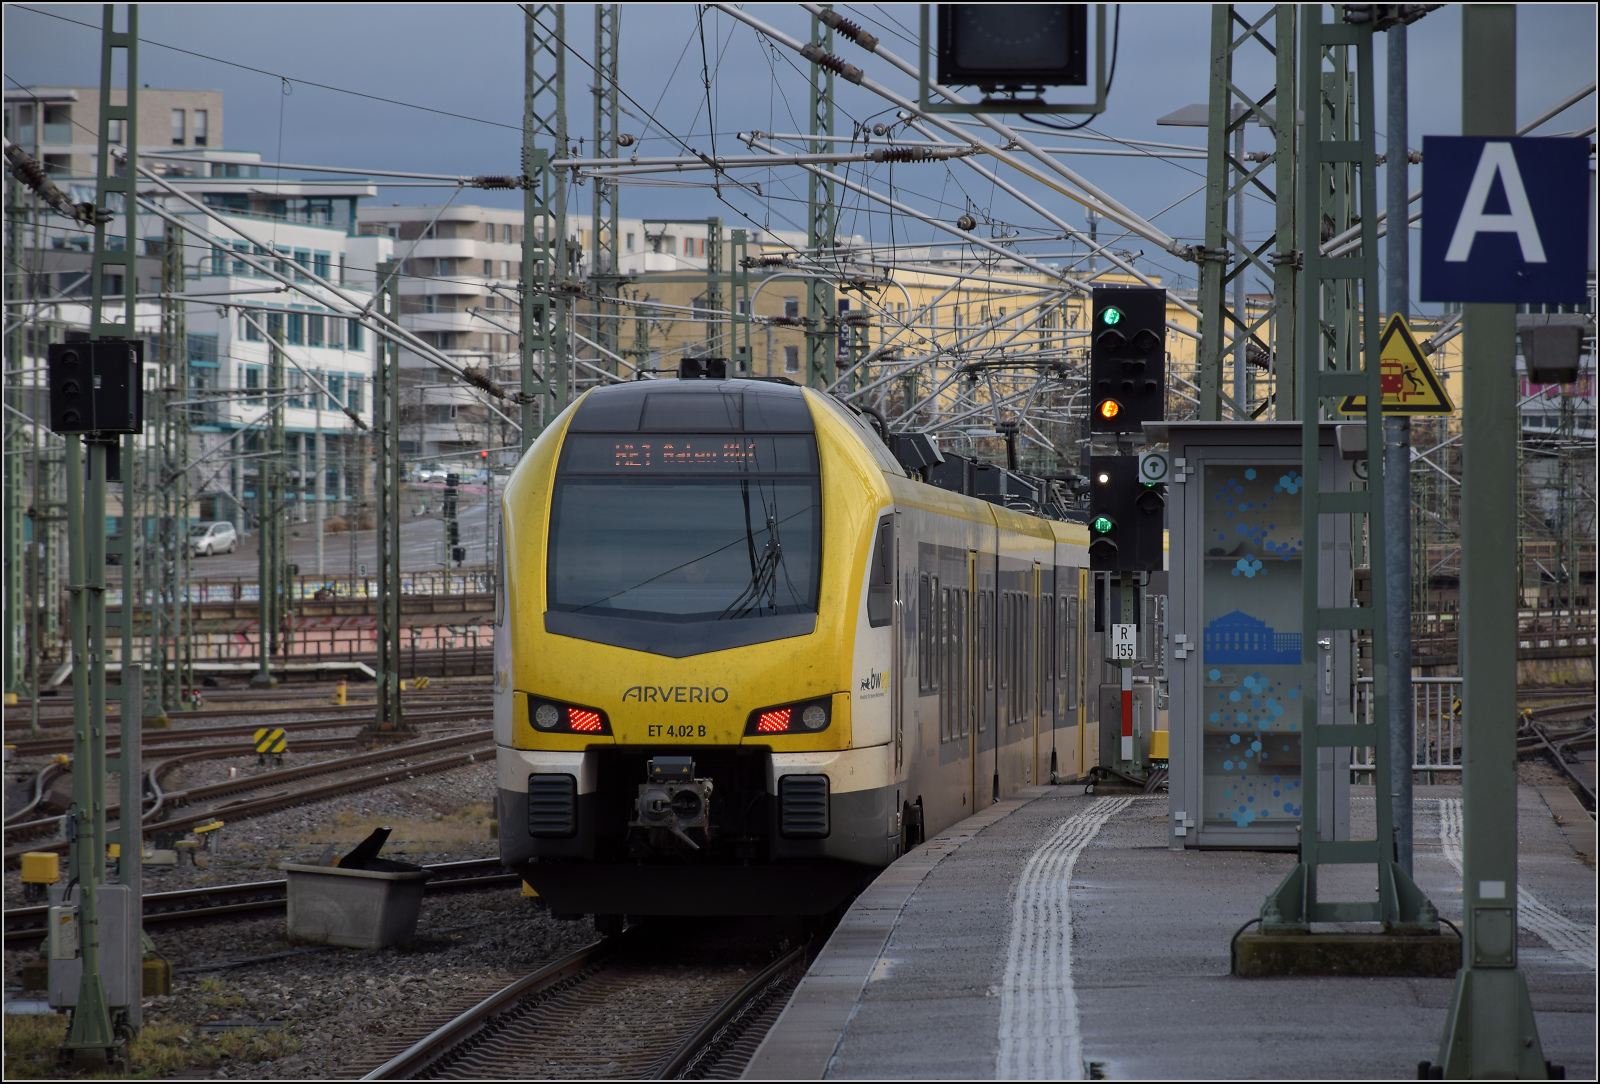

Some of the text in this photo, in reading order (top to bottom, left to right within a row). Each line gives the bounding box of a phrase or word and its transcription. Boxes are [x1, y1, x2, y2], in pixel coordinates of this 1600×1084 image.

[1445, 141, 1548, 264] A
[1121, 627, 1128, 640] R
[1115, 643, 1134, 657] 155
[622, 686, 729, 704] ARVERIO
[648, 725, 663, 737] ET
[698, 725, 707, 737] B
